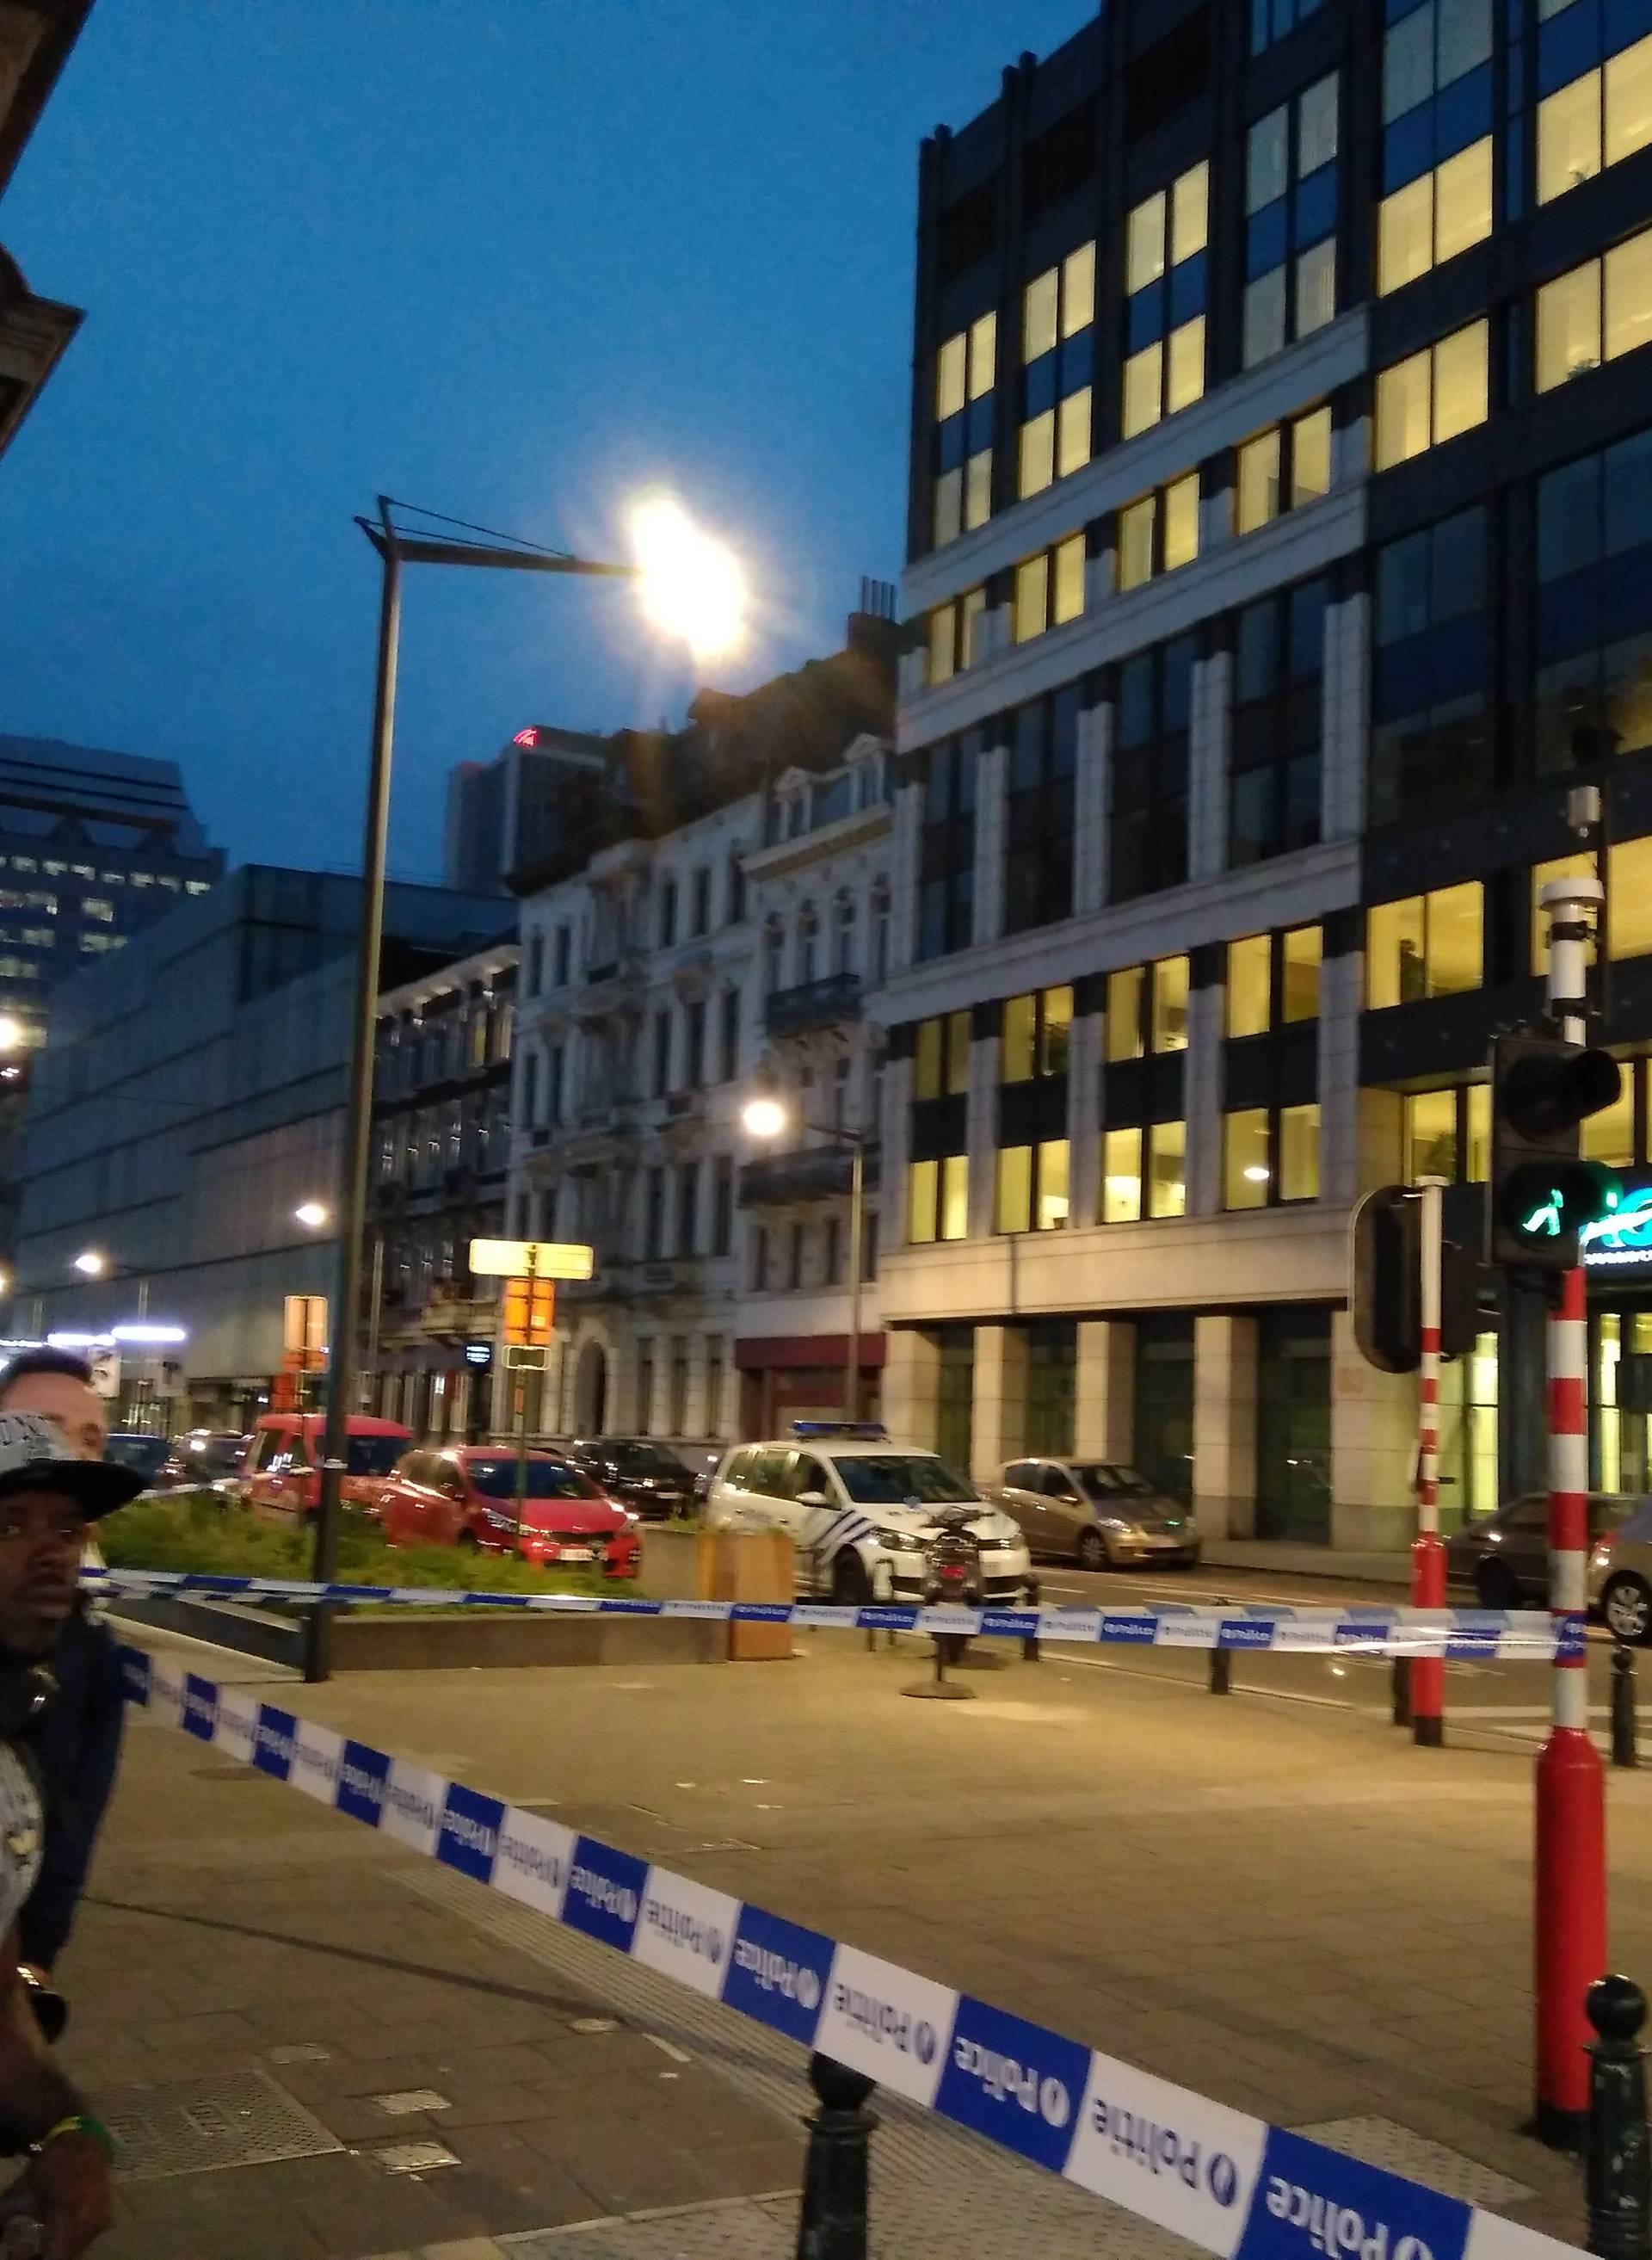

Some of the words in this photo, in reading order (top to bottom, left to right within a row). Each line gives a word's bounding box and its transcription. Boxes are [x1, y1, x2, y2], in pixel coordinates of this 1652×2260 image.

[834, 1983, 912, 2053] Politie
[953, 2036, 1039, 2114] Police
[1093, 2097, 1201, 2190] Politie
[1266, 2175, 1390, 2260] Police
